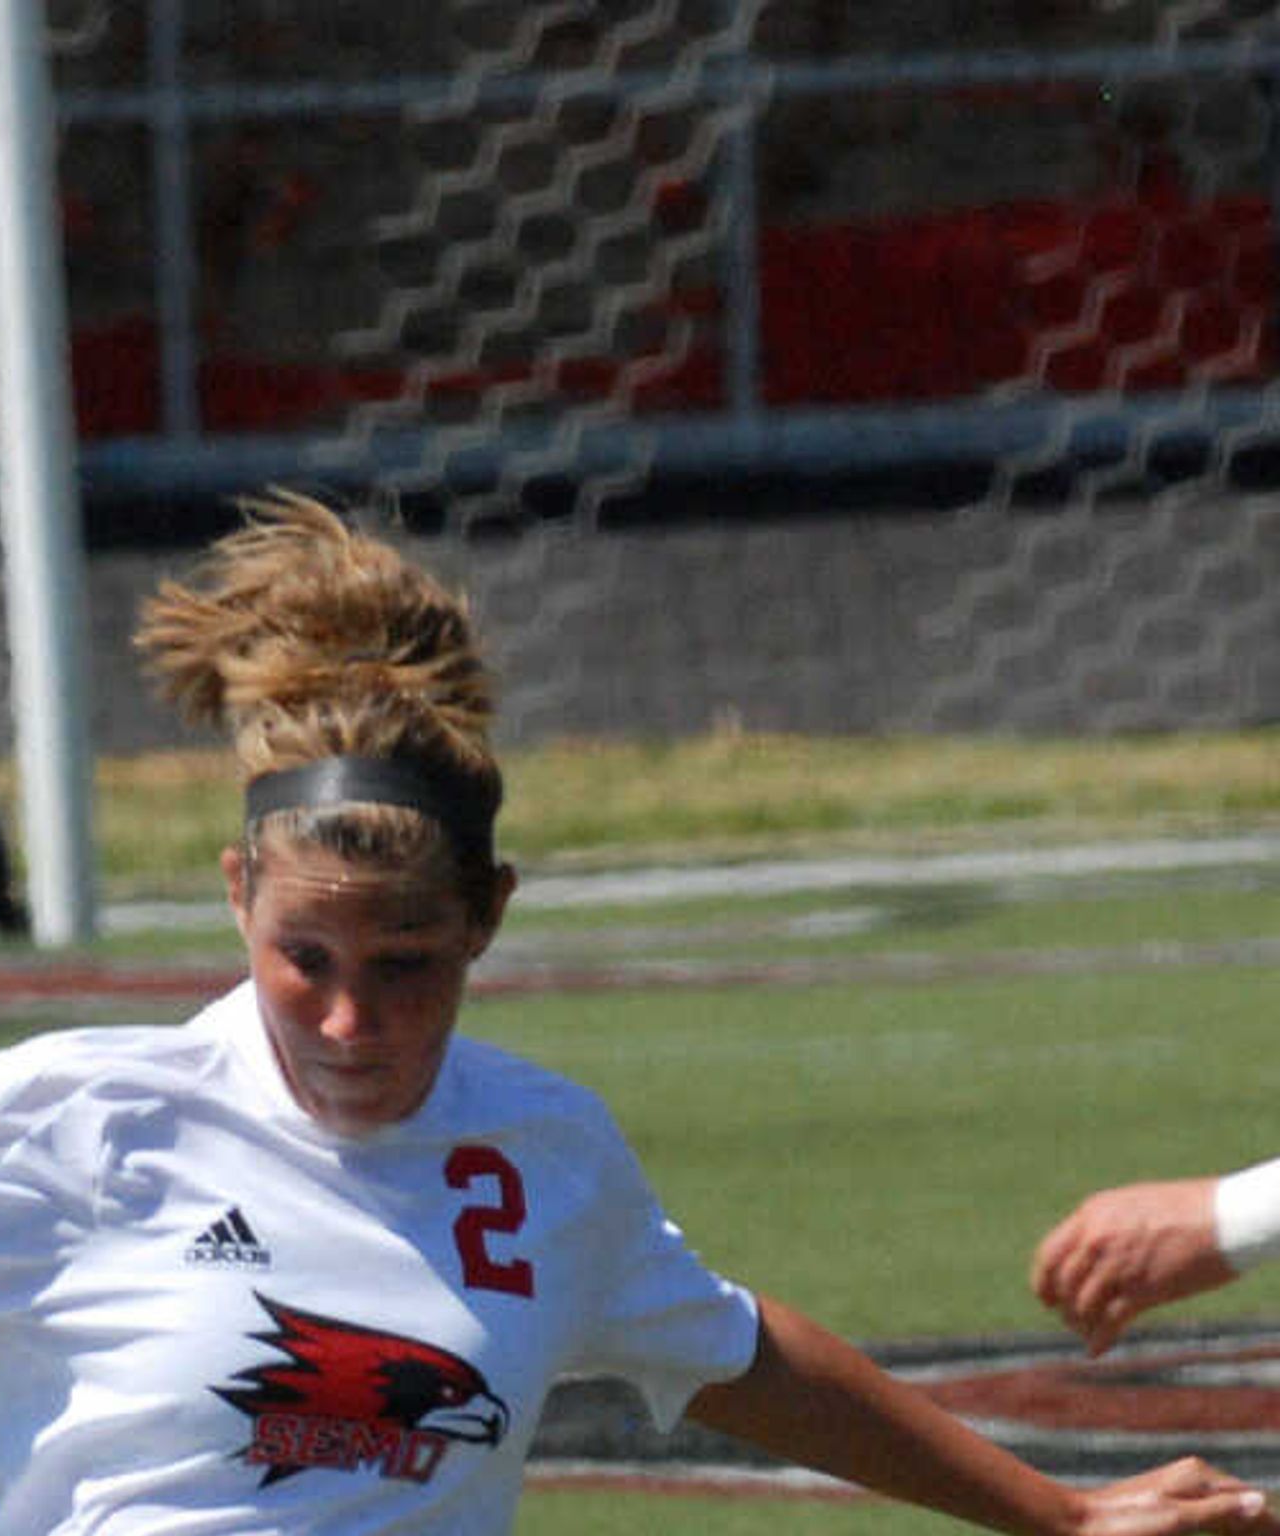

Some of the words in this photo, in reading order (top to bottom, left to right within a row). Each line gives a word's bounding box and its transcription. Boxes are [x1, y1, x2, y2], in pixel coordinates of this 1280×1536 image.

[184, 1240, 271, 1265] adidas
[444, 1145, 534, 1298] 2
[245, 1413, 448, 1484] SEMO
